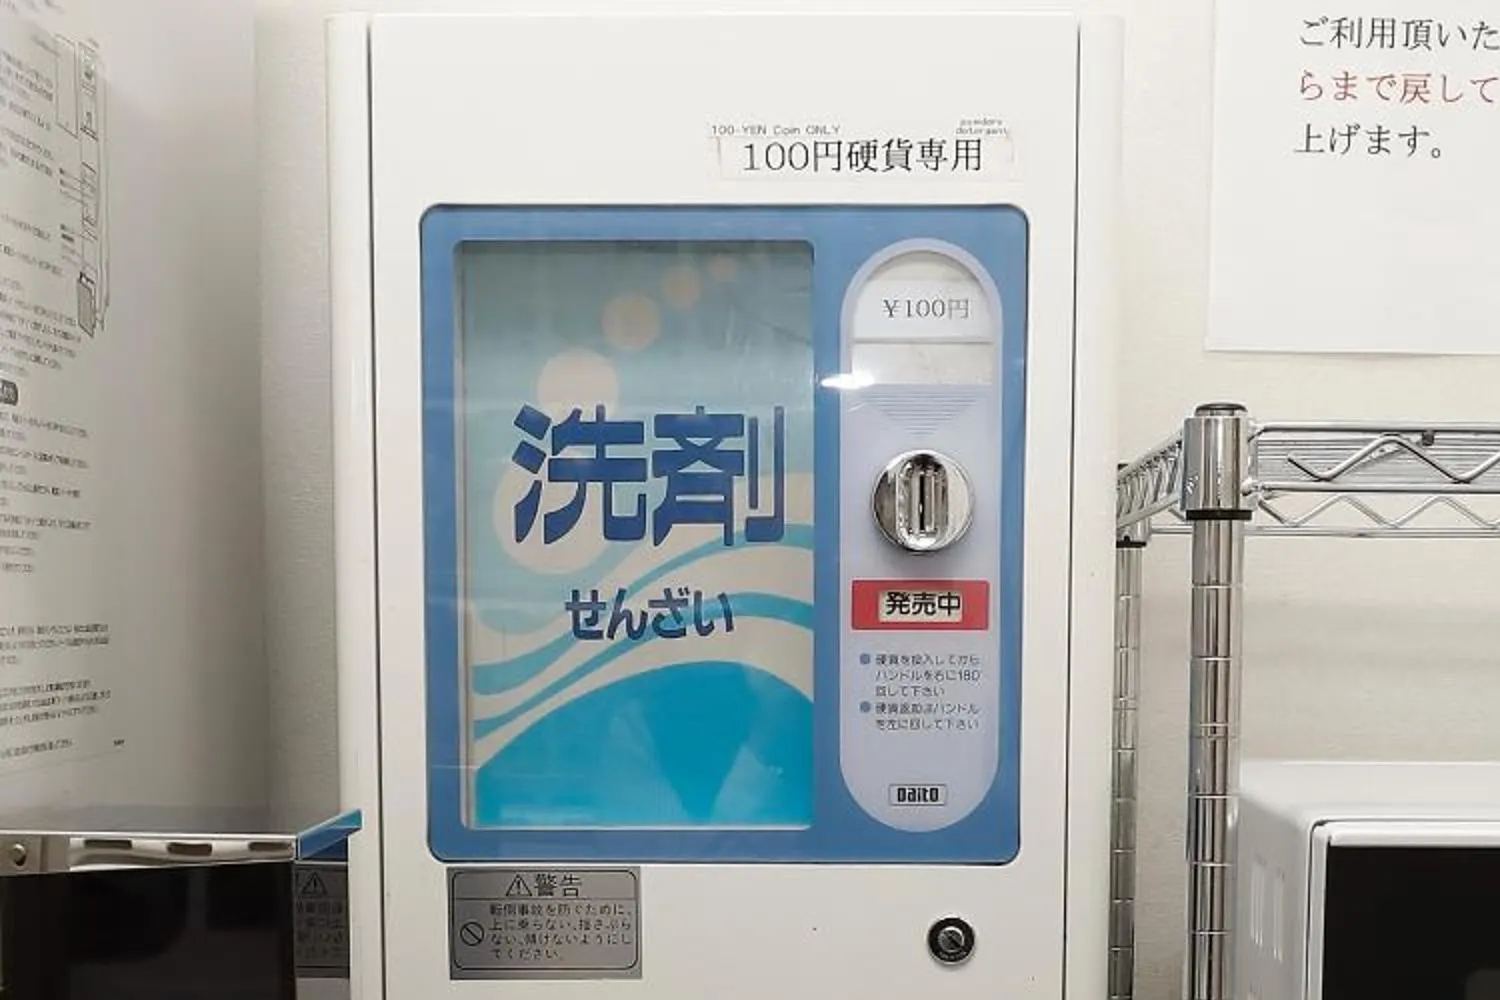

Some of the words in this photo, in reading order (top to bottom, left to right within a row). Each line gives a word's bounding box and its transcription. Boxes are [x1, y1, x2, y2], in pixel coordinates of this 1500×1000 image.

[773, 125, 801, 136] Coin
[805, 125, 841, 136] ONLY
[1294, 123, 1444, 160] 上げます。
[743, 138, 982, 173] 100円硬貨専用
[883, 298, 969, 319] ¥100円
[512, 404, 785, 546] 洗剤
[565, 587, 735, 640] せんざい
[885, 591, 961, 616] 発売中
[534, 873, 583, 897] 警告
